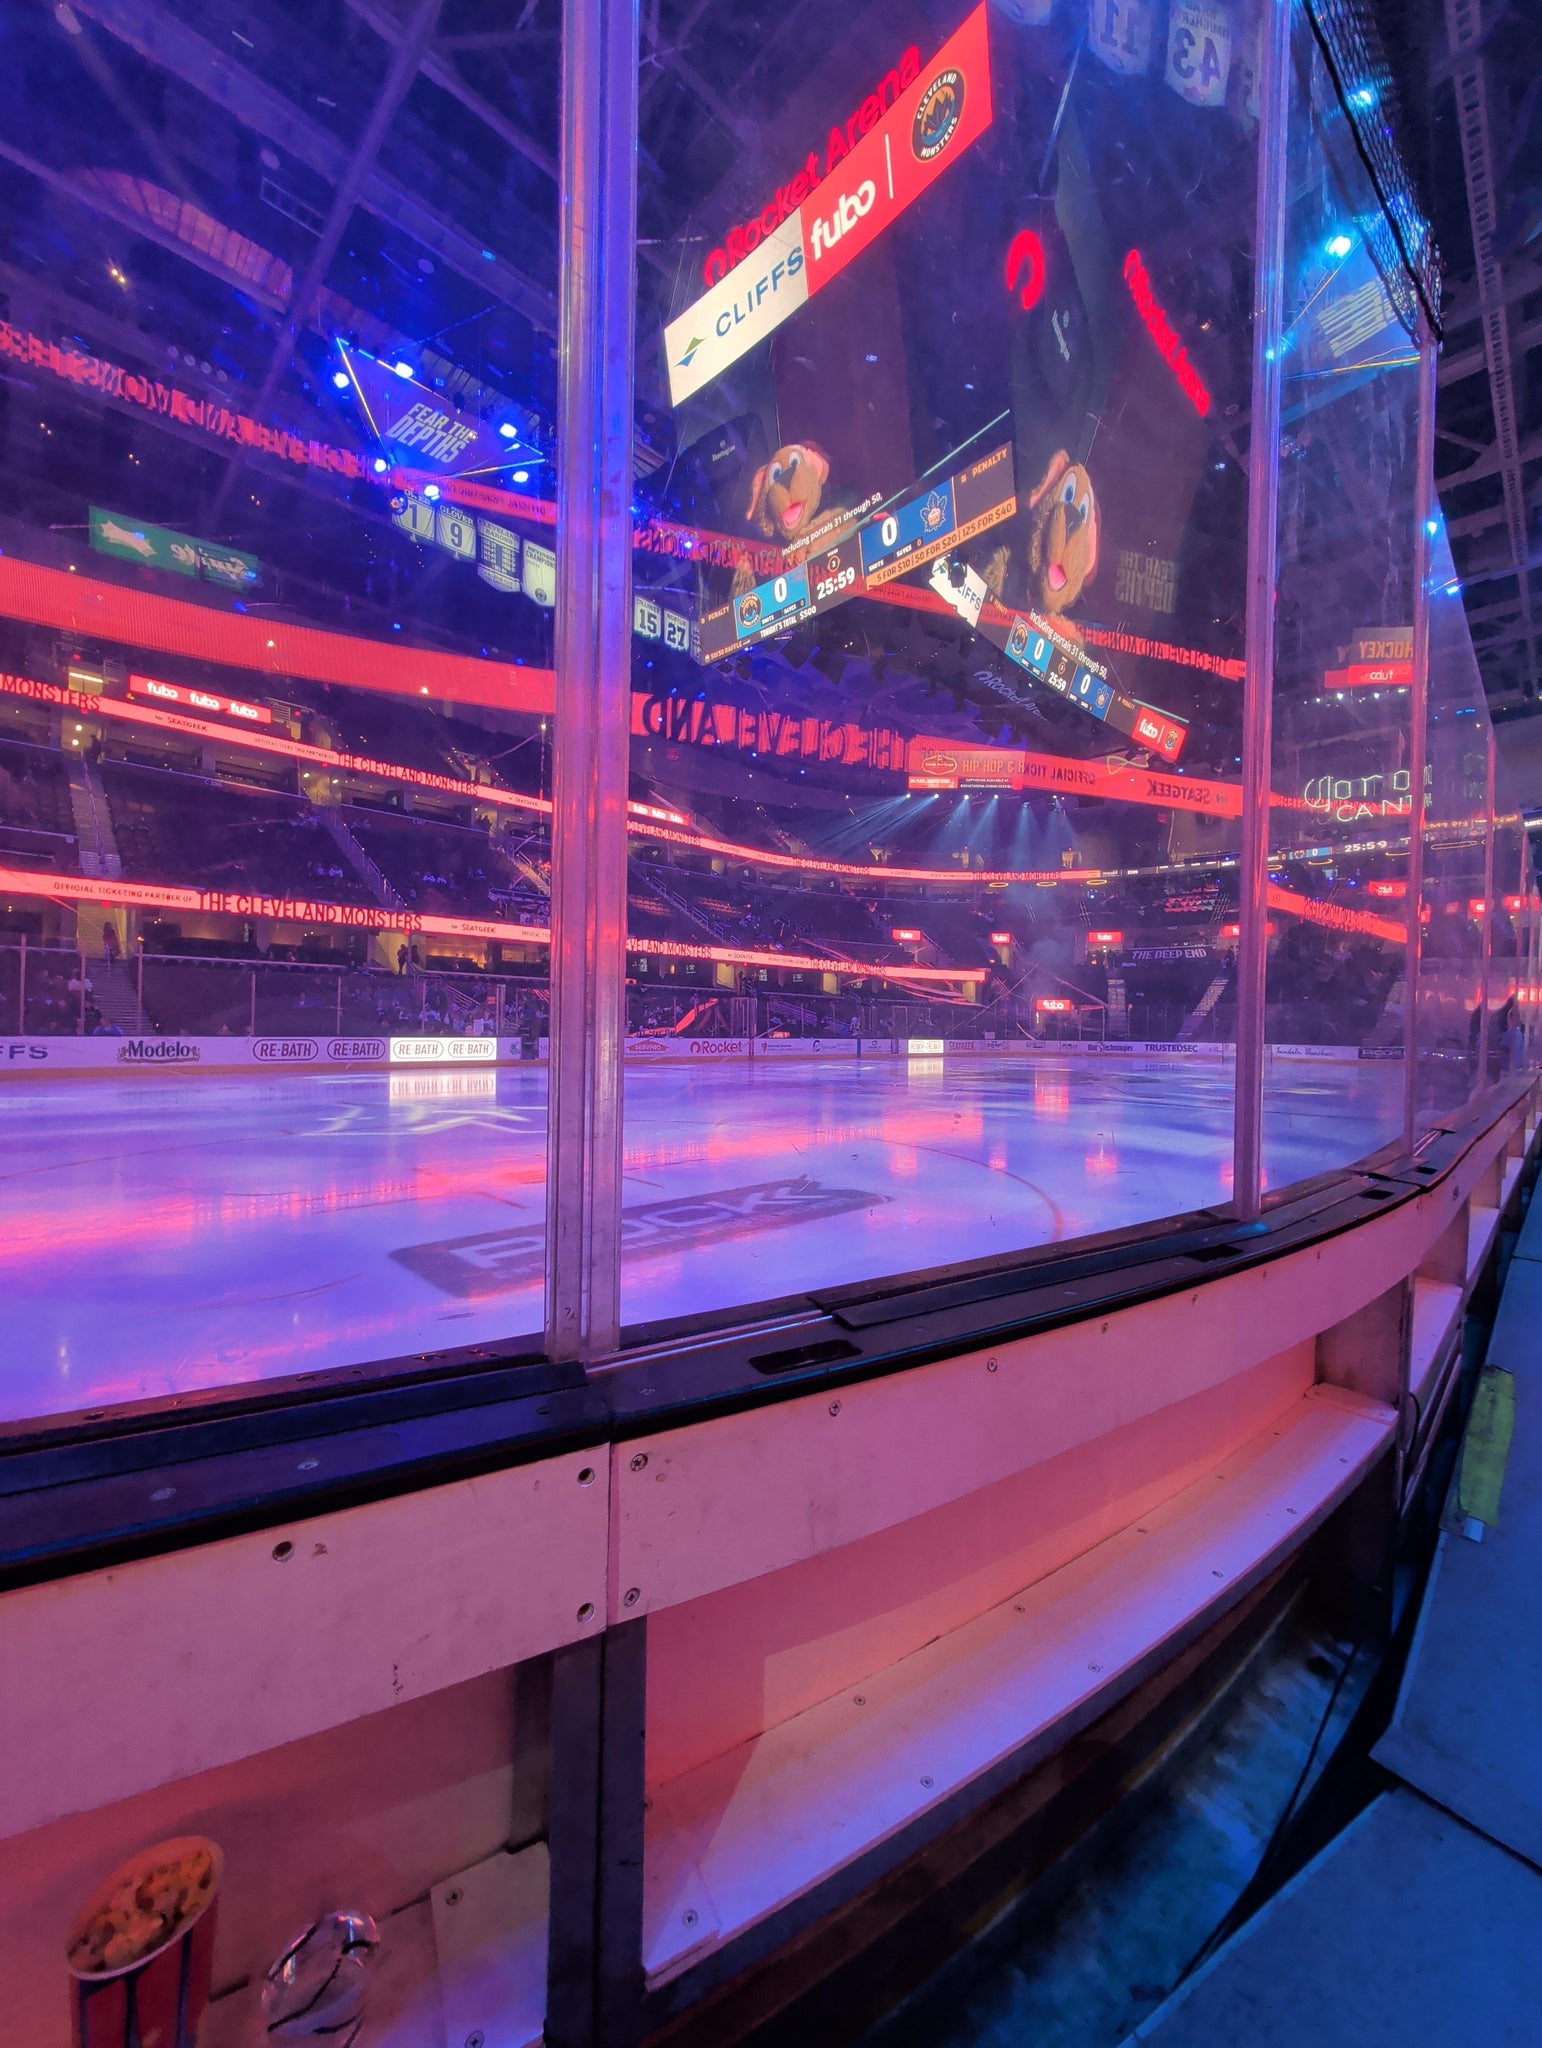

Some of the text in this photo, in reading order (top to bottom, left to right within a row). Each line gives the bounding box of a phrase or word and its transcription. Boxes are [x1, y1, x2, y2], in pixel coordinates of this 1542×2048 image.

[915, 71, 958, 121] CLEVELAND
[919, 115, 960, 160] MONSTERS
[726, 45, 923, 270] Rocket Arena
[809, 179, 877, 262] fubo
[714, 246, 805, 338] CLIFFS
[408, 402, 477, 444] FEAR THE
[385, 416, 468, 464] DEPTHS
[971, 448, 1008, 477] PENALTY
[450, 522, 463, 548] 9
[781, 535, 810, 557] including
[810, 523, 833, 545] portals
[834, 515, 842, 527] 31
[843, 497, 870, 521] through
[882, 516, 897, 547] 0
[882, 566, 897, 580] FOR
[897, 559, 911, 574] $10
[914, 552, 925, 563] 50
[925, 544, 941, 559] FOR
[942, 534, 957, 550] $20
[962, 523, 977, 537] 125
[977, 514, 994, 531] FOR
[995, 502, 1012, 521] $40
[774, 577, 787, 603] 0
[816, 566, 855, 600] 25:59
[639, 608, 657, 634] 15
[708, 604, 730, 621] PENALTY
[799, 605, 817, 621] $500
[667, 622, 686, 647] 27
[1030, 608, 1054, 640] including
[1052, 630, 1072, 654] portals
[1070, 645, 1079, 657] 31
[1078, 650, 1099, 674] through
[1033, 638, 1044, 660] 0
[0, 674, 100, 712] MONSTERS
[147, 681, 179, 700] fubo
[1048, 671, 1067, 692] 25:59
[1080, 673, 1091, 694] 0
[190, 692, 220, 709] fubo
[230, 702, 259, 719] fubo
[360, 757, 424, 785] CLEVELAND
[424, 772, 479, 796] MONSTERS
[963, 760, 978, 772] HIP
[984, 760, 1003, 772] HOP
[1345, 840, 1387, 853] 25:59
[53, 881, 94, 893] OFFICIAL
[98, 886, 142, 898] TICKETING
[145, 891, 181, 902] PARTNER
[236, 894, 337, 922] CLEVELAND
[341, 905, 423, 931] MONSTERS
[668, 942, 712, 959] MONSTERS
[1132, 948, 1207, 959] THE DEEP END
[127, 1040, 190, 1058] Modelo
[702, 1041, 743, 1054] Rocket
[1144, 1043, 1198, 1053] TRUSTEDSEC
